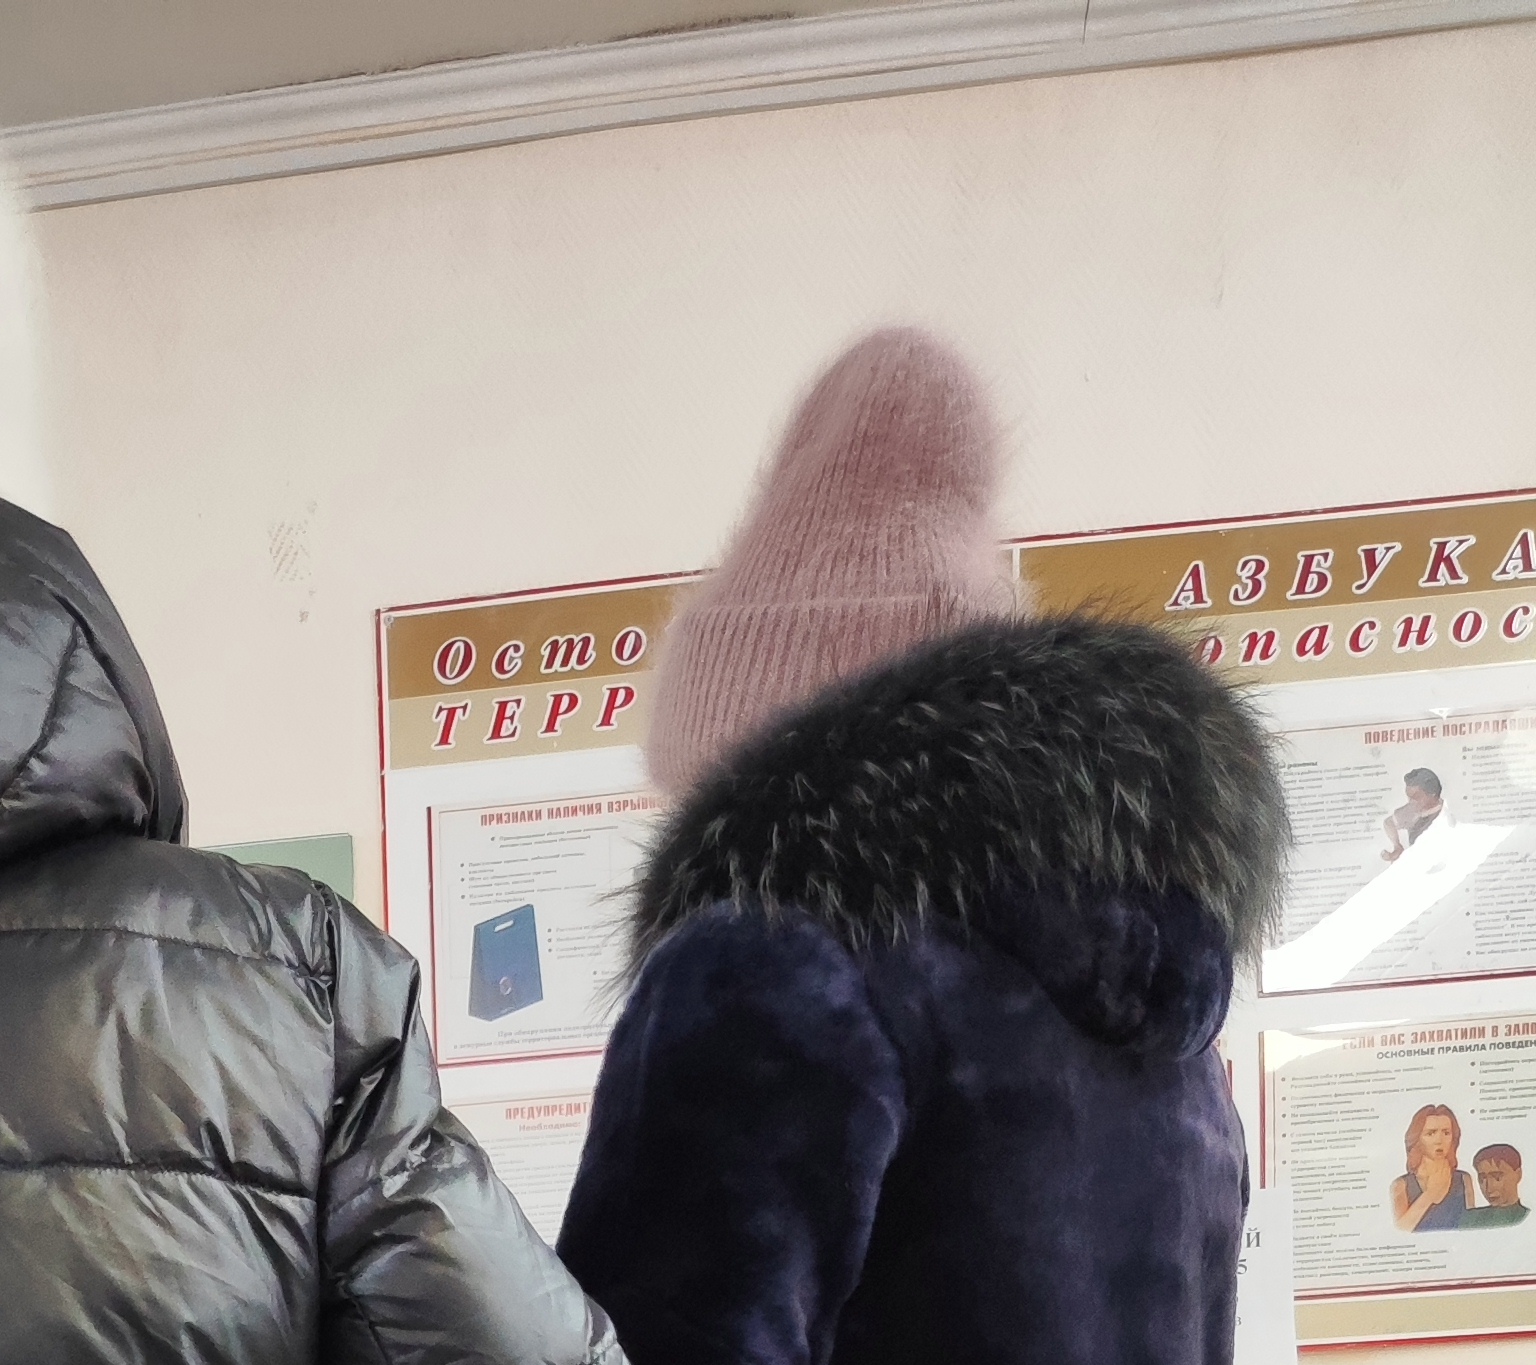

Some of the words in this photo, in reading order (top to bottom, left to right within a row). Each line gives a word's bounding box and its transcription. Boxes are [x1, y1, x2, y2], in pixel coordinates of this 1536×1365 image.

[1167, 530, 1536, 610] АЗБУКА
[1364, 725, 1437, 745] ПОВЕДЕНИЕ
[480, 809, 543, 827] ПРИЗНАКИ
[547, 802, 603, 820] НАЛИЧИЯ
[1380, 1033, 1406, 1047] ВАС
[1410, 1026, 1486, 1044] ЗАХВАТИЛИ
[1491, 1025, 1499, 1038] В
[1376, 1047, 1435, 1060] ОСНОВНЫЕ
[1437, 1044, 1486, 1055] ПРАВИЛА
